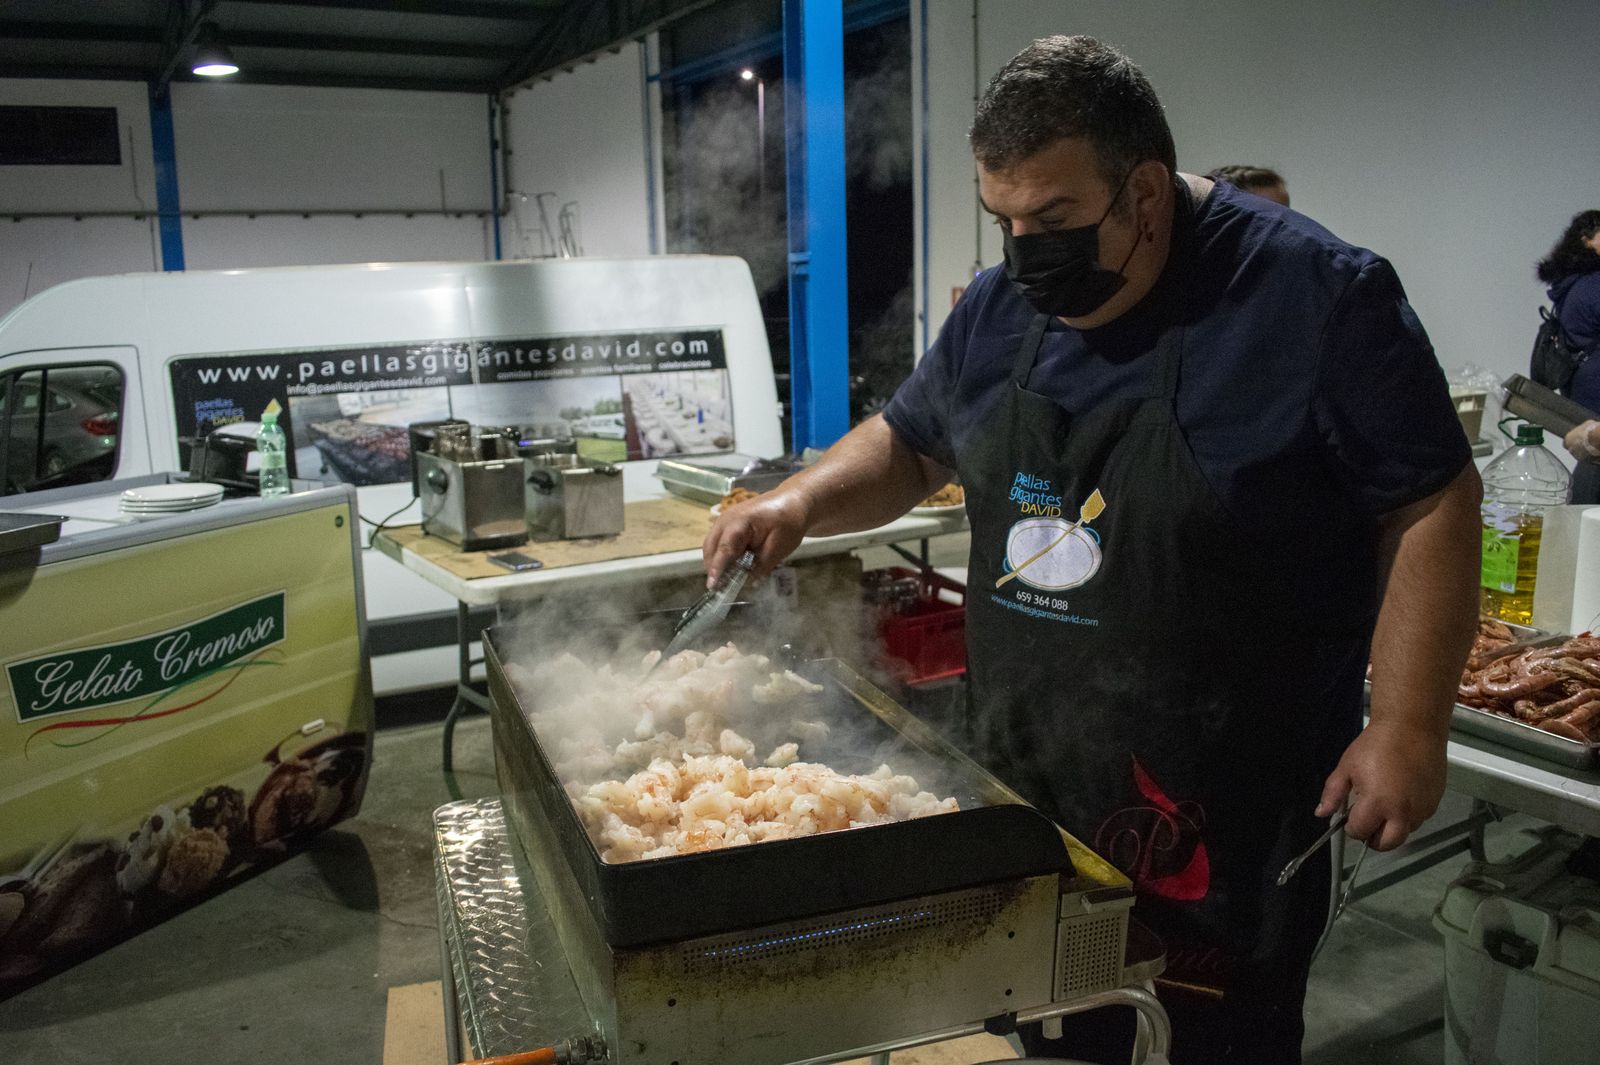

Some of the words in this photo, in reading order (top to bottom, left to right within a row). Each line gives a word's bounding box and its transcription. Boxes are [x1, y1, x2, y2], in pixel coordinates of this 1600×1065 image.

[197, 338, 710, 385] www.paellasgigantesdavid.com
[1021, 501, 1062, 517] DAVID
[1016, 591, 1032, 603] 659
[1033, 594, 1050, 607] 364
[1051, 599, 1069, 611] 088
[31, 653, 143, 711] Gelato
[153, 615, 276, 680] Cremoso
